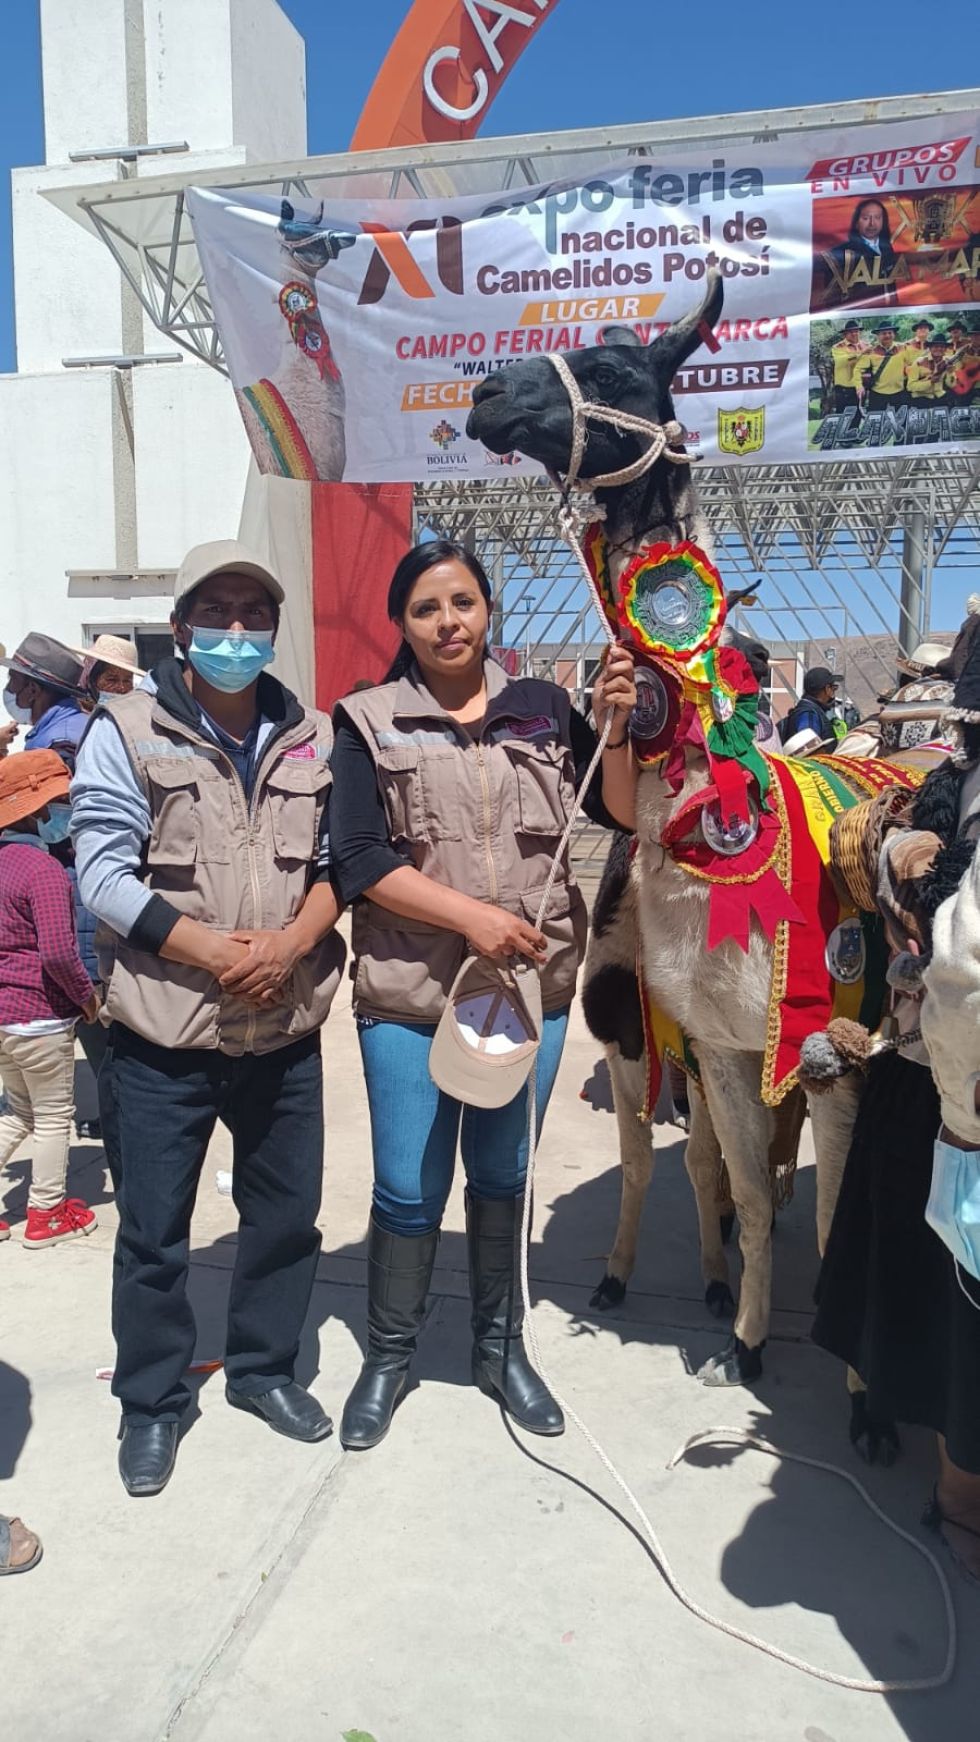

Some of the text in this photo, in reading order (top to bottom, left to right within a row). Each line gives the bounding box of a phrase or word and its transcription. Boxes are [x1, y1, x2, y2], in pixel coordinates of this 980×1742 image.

[423, 0, 549, 122] CA
[828, 141, 956, 177] GRUPOS
[628, 158, 764, 210] feria
[810, 162, 957, 194] EN VIVO
[561, 210, 767, 254] nacional de
[357, 215, 465, 305] XI
[476, 245, 770, 295] Camelidos Potosí
[540, 297, 640, 323] LUGAR
[396, 331, 486, 361] CAMPO
[494, 326, 587, 354] FERIAL
[407, 383, 474, 405] FECH
[670, 364, 780, 390] TUBRE
[426, 454, 468, 466] BOLIVIA
[809, 770, 845, 813] OBIERNO
